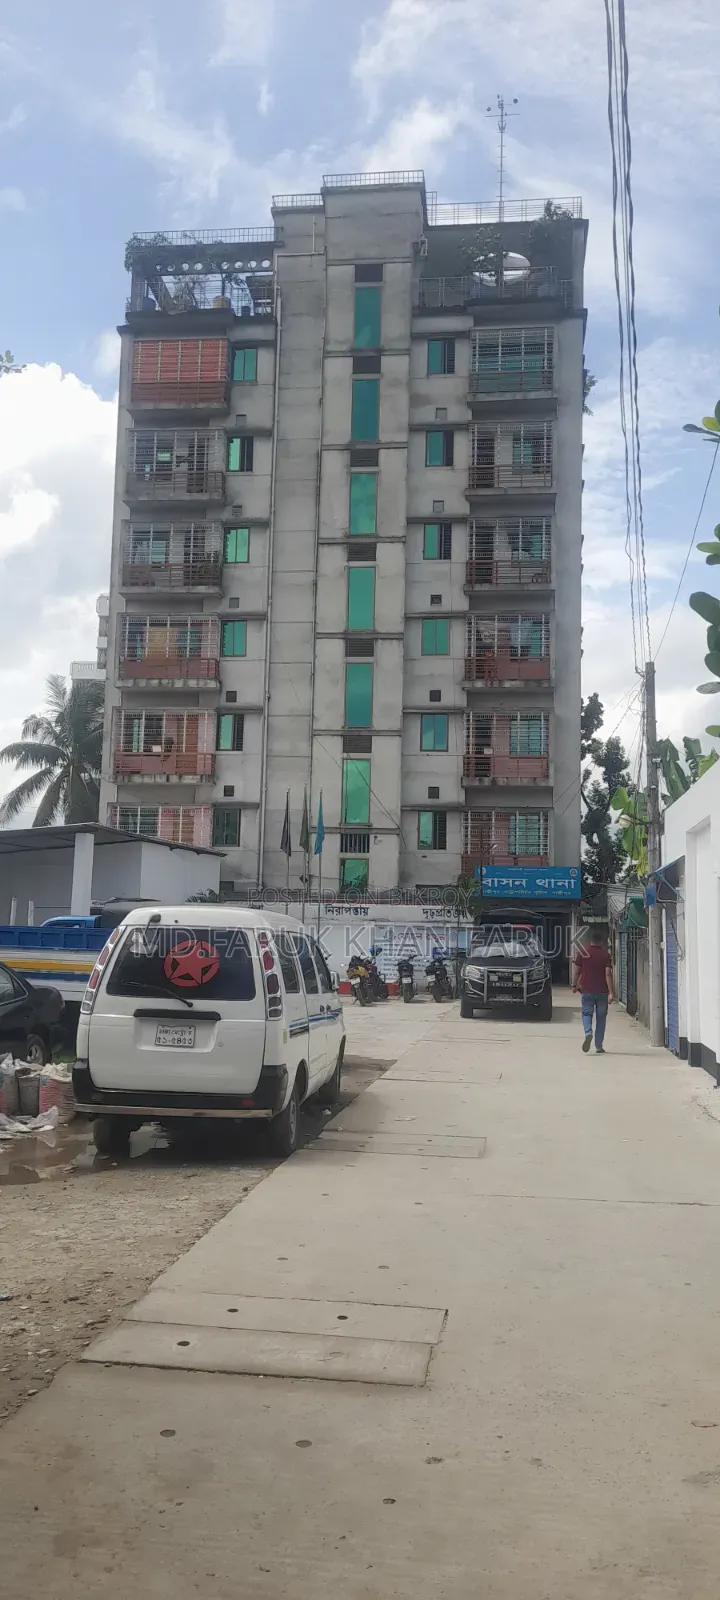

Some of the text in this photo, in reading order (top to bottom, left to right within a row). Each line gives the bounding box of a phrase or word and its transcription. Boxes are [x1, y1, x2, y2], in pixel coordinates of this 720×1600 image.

[483, 877, 577, 889] বাসন থানা
[324, 904, 370, 916] নিরাপত্তায়
[156, 1036, 193, 1045] ৫১-৫৪৫০
